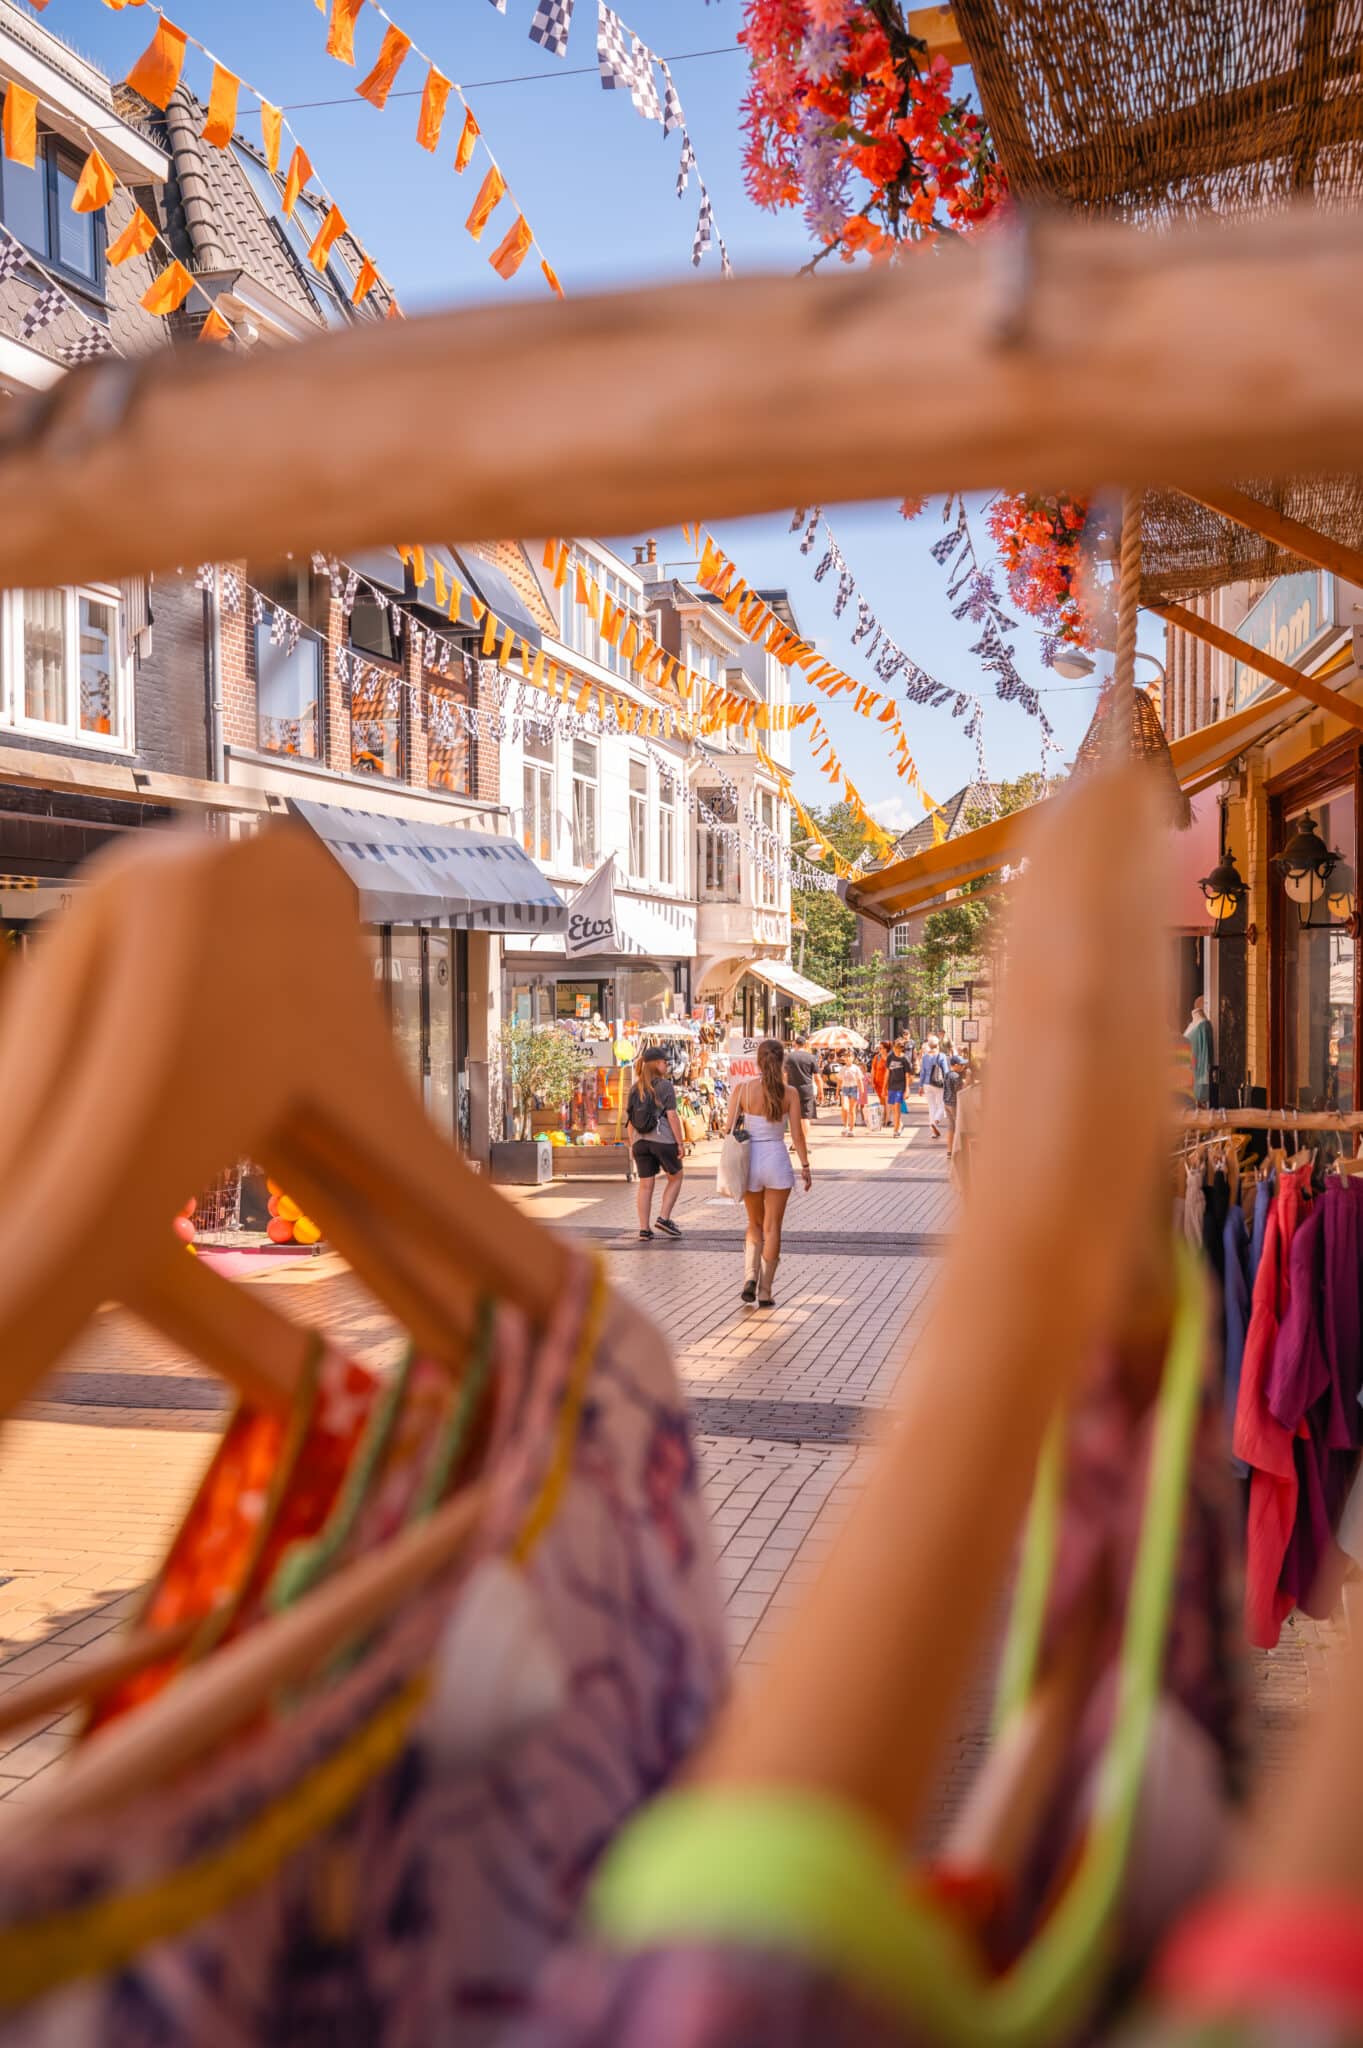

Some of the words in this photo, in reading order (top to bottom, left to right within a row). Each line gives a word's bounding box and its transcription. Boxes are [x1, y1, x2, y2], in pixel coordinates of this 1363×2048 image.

[568, 914, 614, 941] Etos
[743, 1038, 761, 1050] Eto
[729, 1060, 761, 1077] WAL
